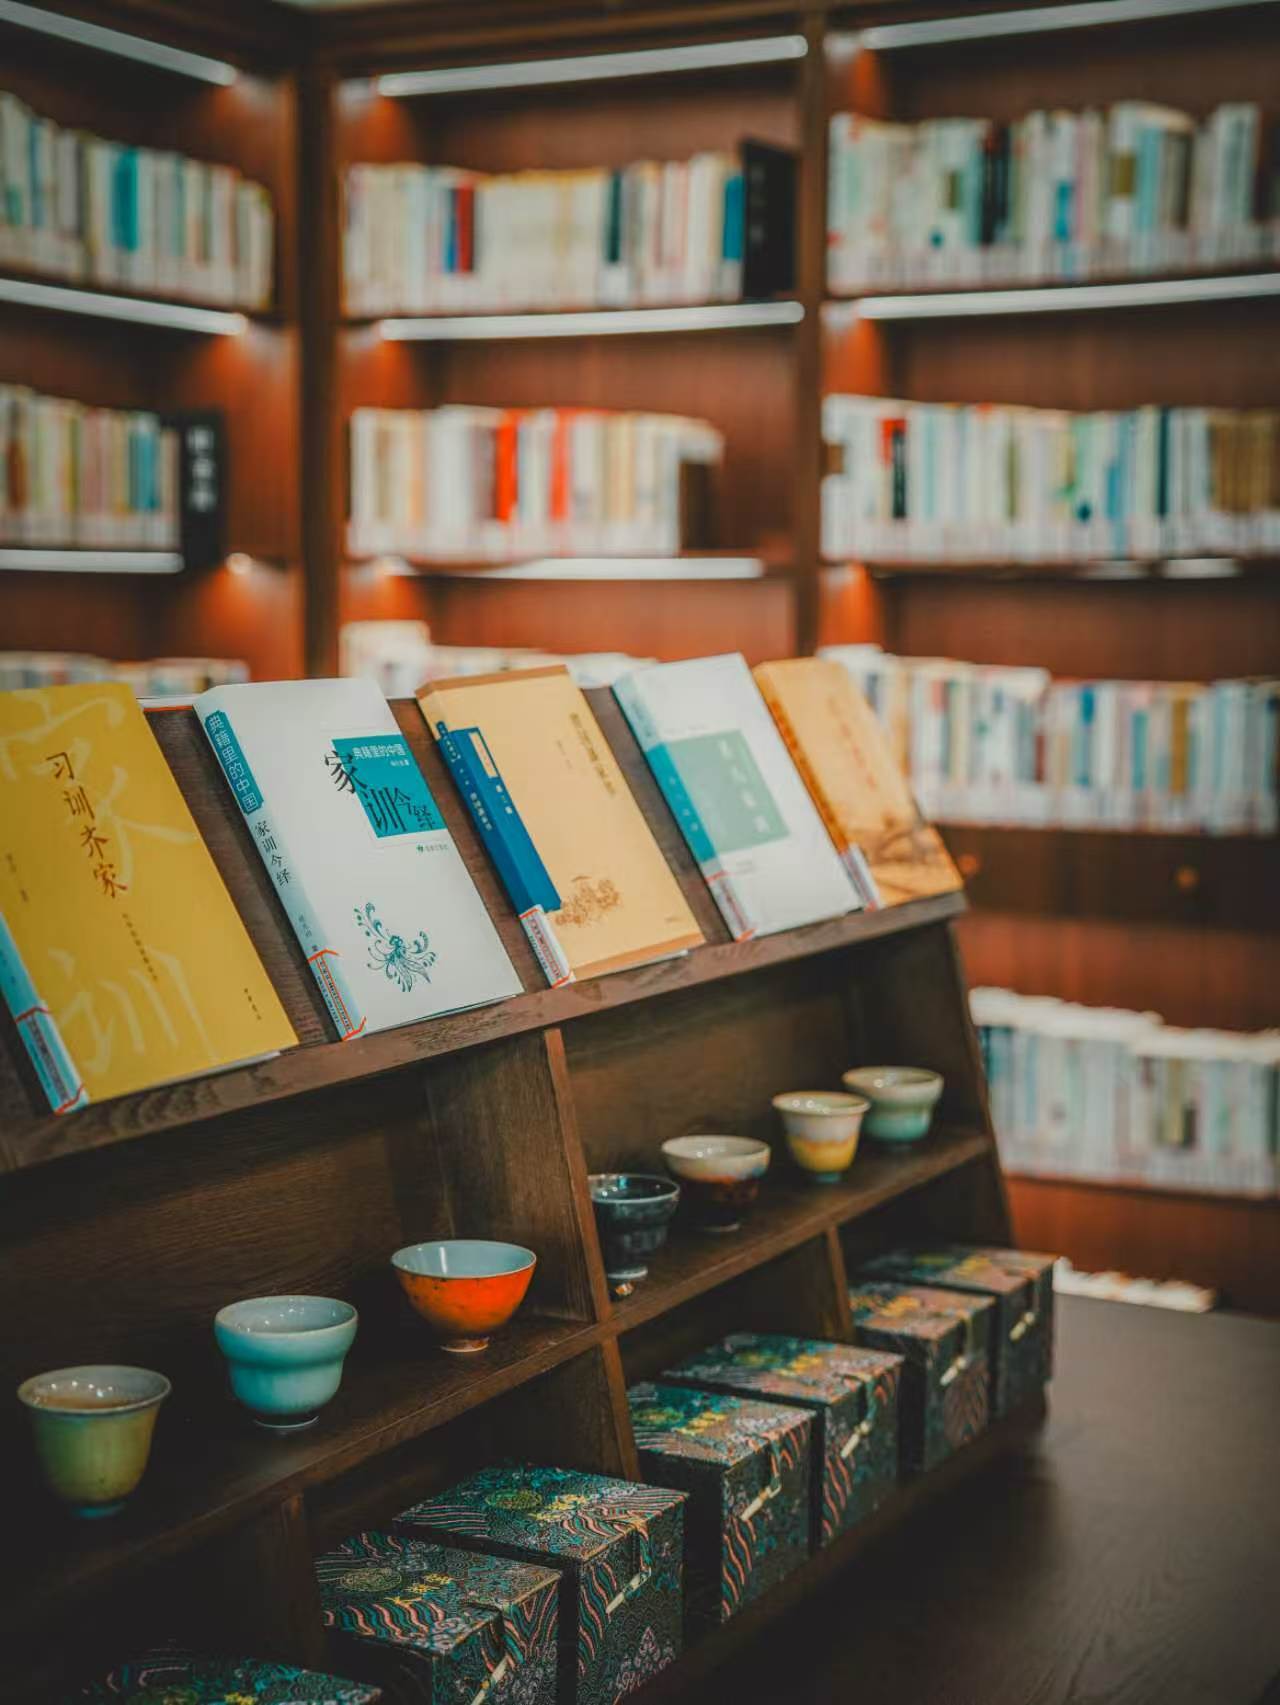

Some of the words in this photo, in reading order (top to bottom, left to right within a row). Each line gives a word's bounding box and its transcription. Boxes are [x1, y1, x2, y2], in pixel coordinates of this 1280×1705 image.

[46, 751, 129, 899] 习训齐家
[208, 714, 259, 813] 典籍里的中国
